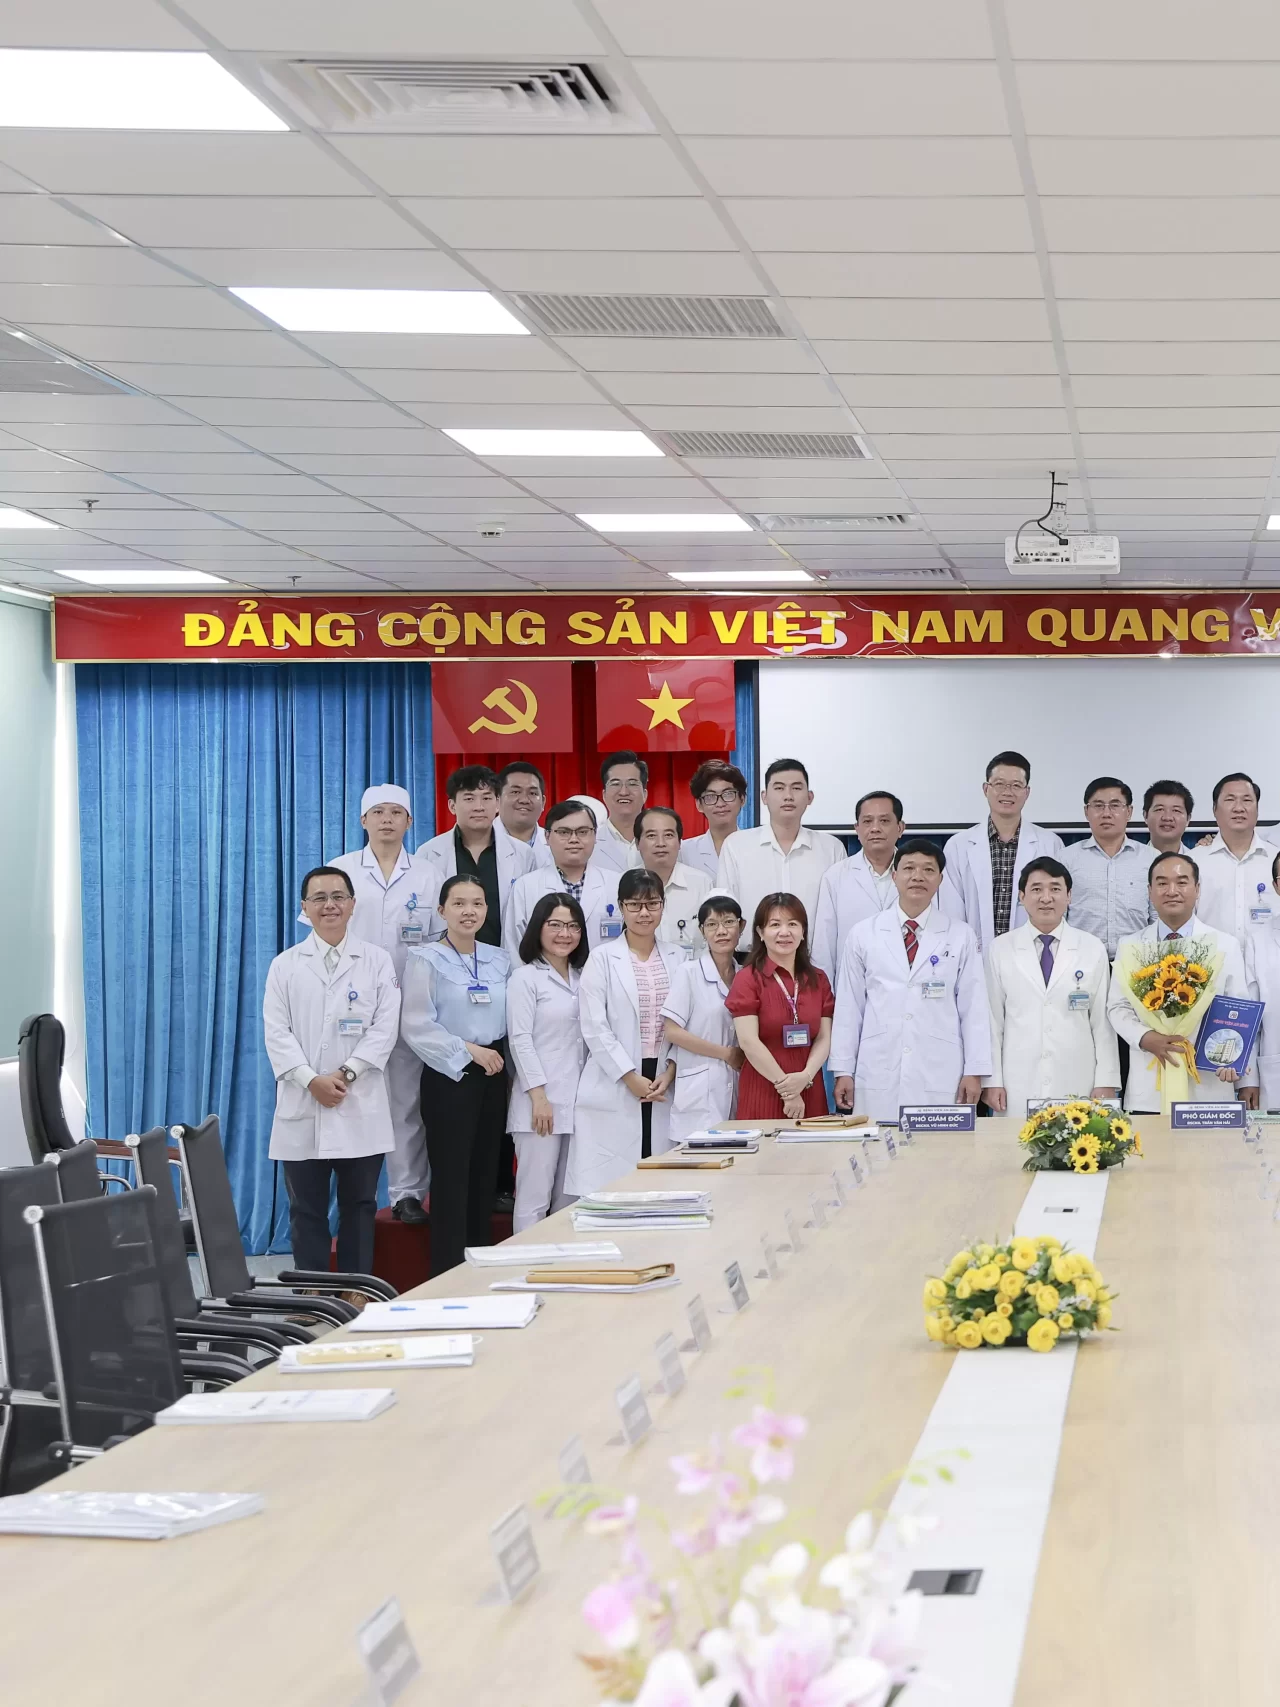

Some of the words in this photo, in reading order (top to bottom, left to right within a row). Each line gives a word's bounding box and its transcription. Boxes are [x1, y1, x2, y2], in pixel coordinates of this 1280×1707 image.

[181, 599, 356, 648] ĐẢNG
[376, 601, 546, 654] CỘNG
[566, 597, 687, 647] SẢN
[709, 601, 847, 653] VIỆT
[872, 609, 1003, 644] NAM
[1026, 607, 1230, 648] QUANG
[948, 1114, 965, 1122] ĐỐC
[1219, 1111, 1236, 1119] ĐỐC
